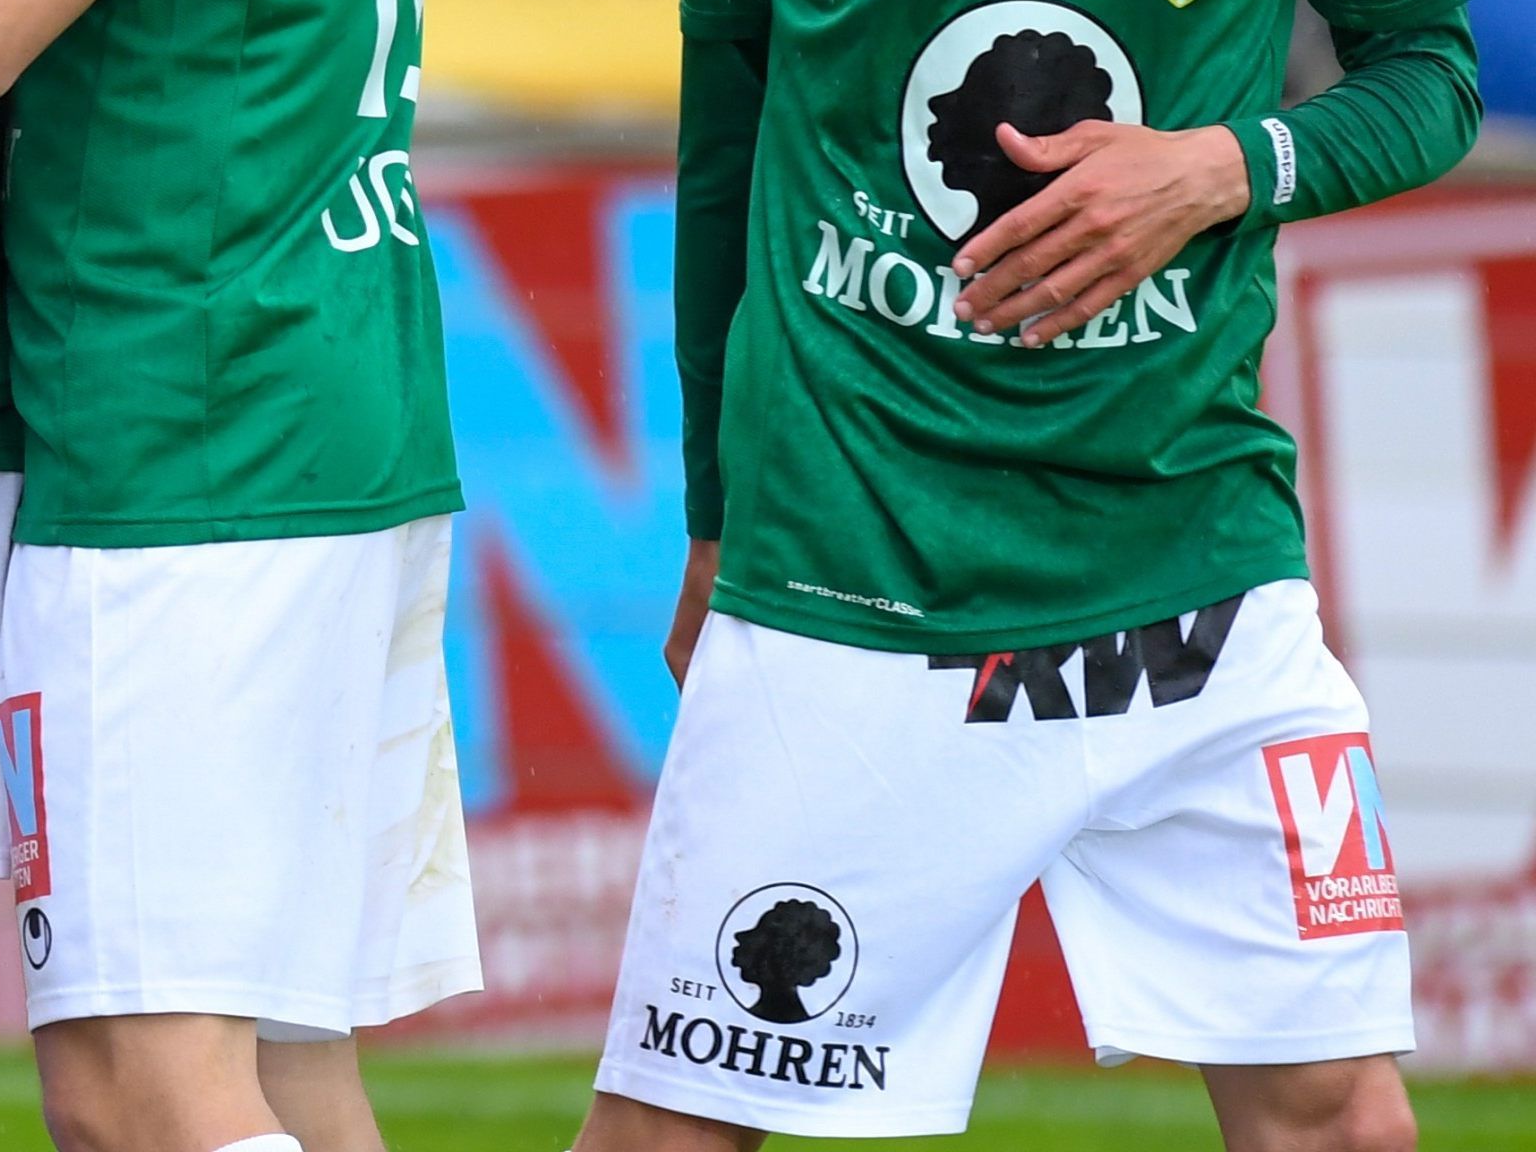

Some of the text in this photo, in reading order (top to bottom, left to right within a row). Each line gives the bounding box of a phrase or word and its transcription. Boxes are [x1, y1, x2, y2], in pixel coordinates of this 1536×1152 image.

[852, 190, 915, 239] SEIT
[670, 977, 717, 1001] SEIT
[834, 1010, 877, 1029] 1834
[639, 1003, 891, 1091] MOHREN
